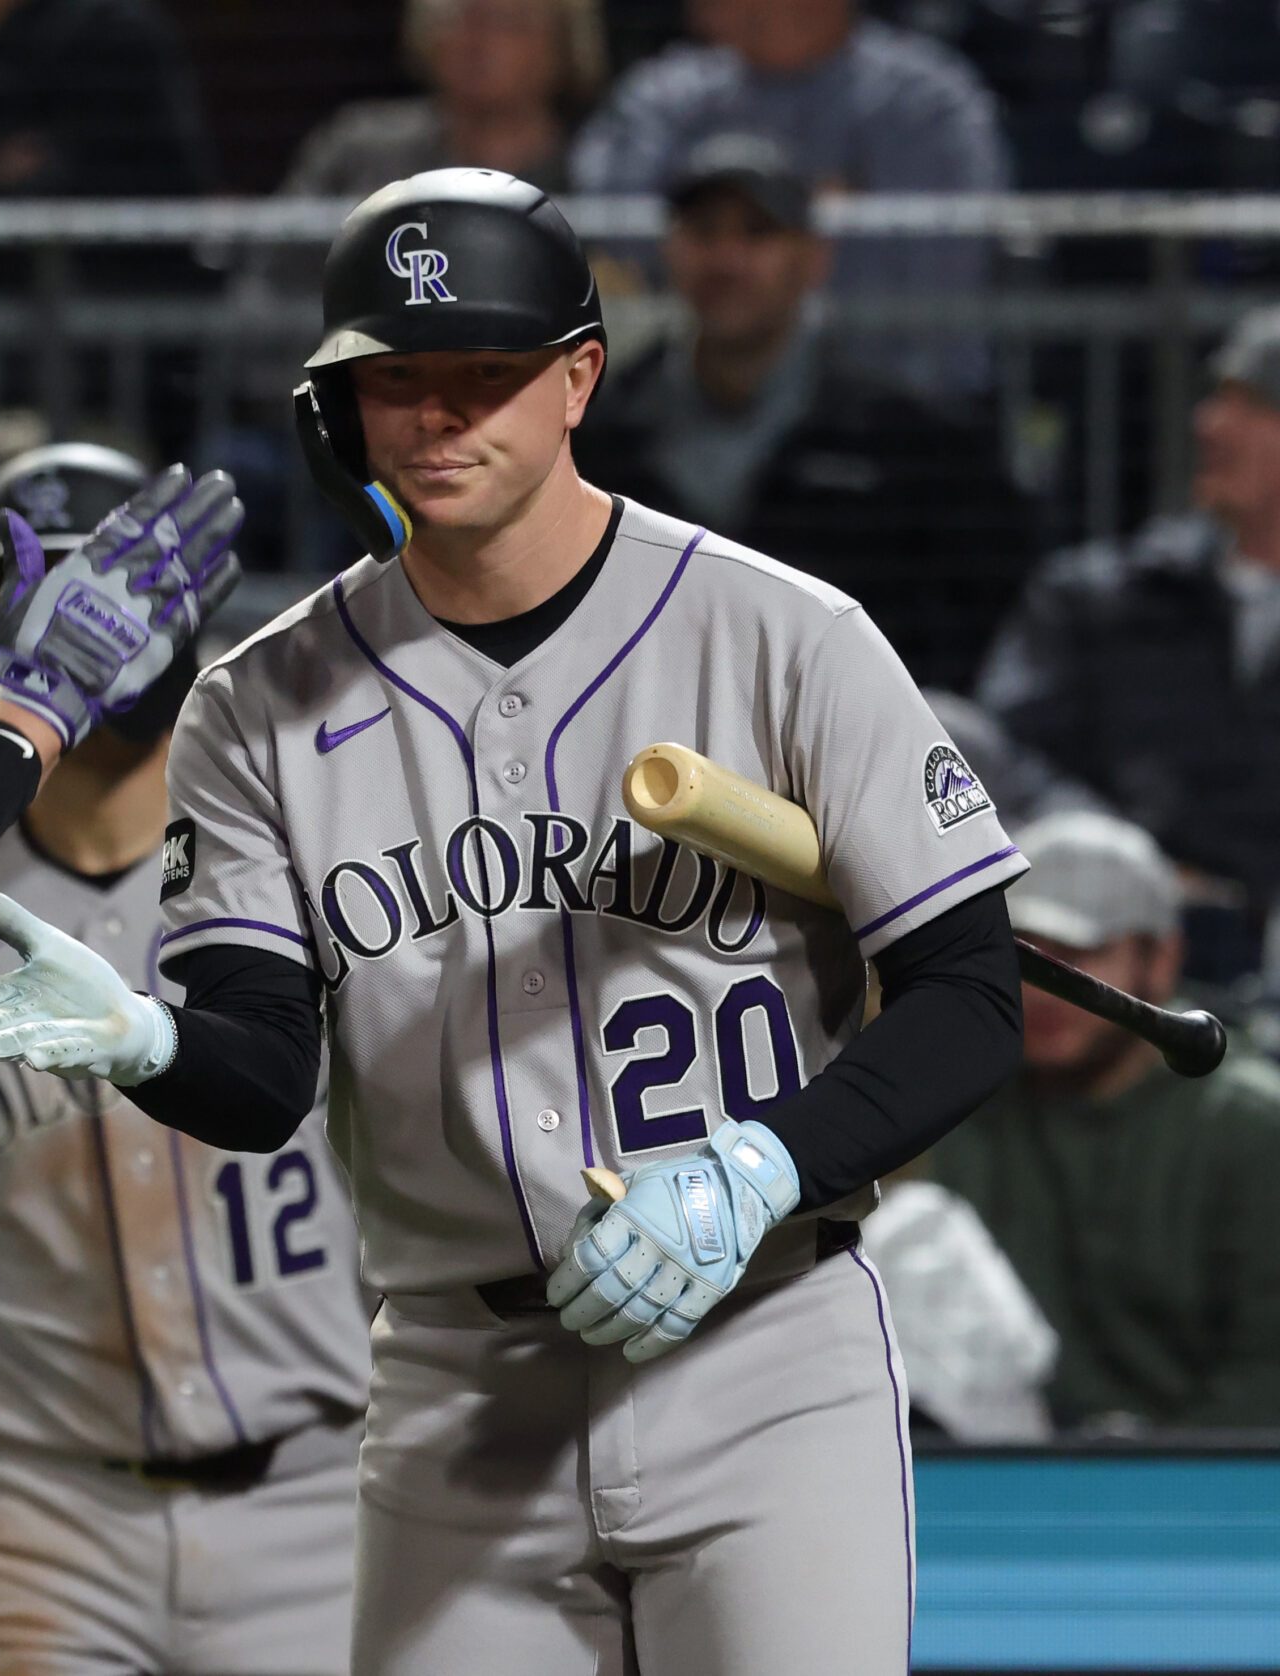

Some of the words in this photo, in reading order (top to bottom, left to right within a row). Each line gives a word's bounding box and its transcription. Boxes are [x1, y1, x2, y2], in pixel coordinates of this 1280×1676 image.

[385, 222, 458, 306] CR
[600, 970, 804, 1157] 20
[214, 1147, 328, 1287] 12
